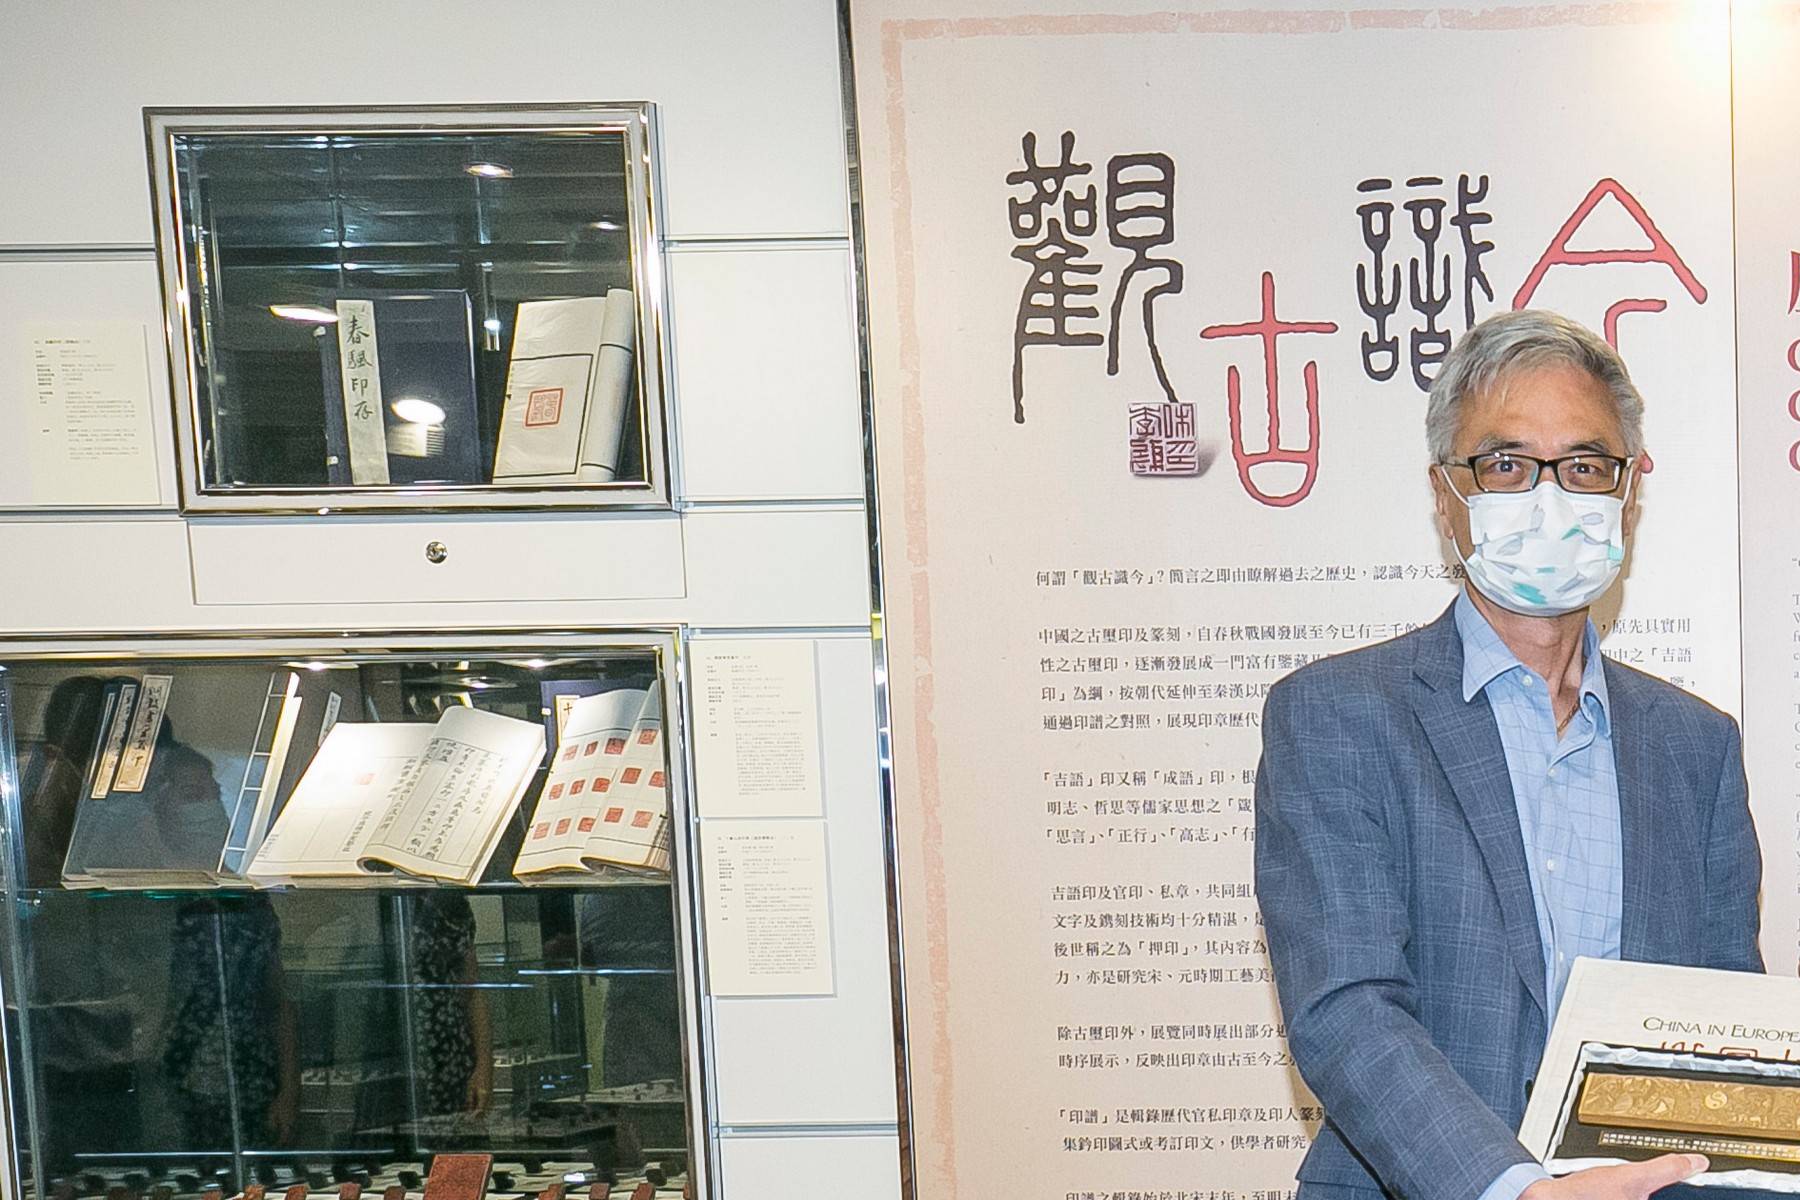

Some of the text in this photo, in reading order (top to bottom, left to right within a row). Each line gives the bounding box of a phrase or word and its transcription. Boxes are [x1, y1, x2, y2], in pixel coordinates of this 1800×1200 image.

[1051, 883, 1254, 900] 吉語印及官印、私章，共同組
[1055, 968, 1275, 985] 力，亦是研究宋、元時期工藝美
[1058, 1051, 1296, 1069] 時序展示，反映出印章由古至今之
